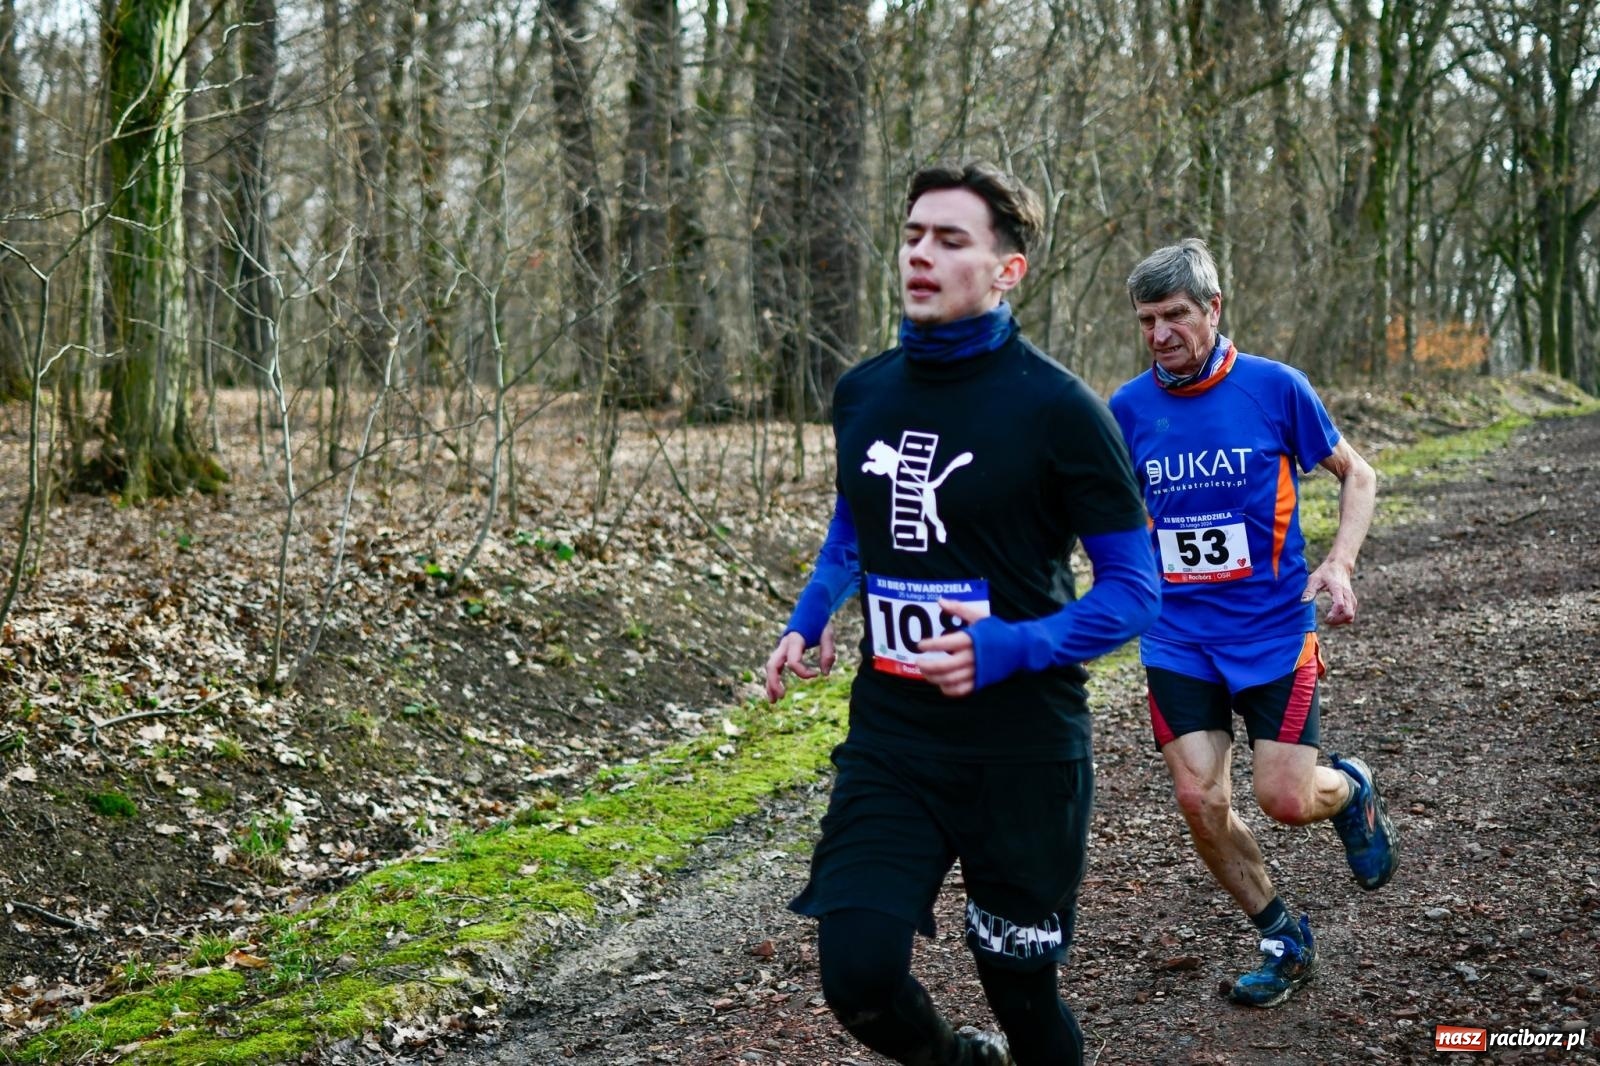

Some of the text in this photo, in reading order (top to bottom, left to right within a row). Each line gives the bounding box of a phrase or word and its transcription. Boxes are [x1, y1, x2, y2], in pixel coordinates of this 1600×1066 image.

[1145, 447, 1252, 485] DUKAT
[1152, 478, 1247, 495] www.dukatrolety.pl
[1163, 511, 1232, 524] XII BIEG TWARDZIELA
[1175, 529, 1230, 567] 53
[877, 578, 973, 594] XII BIEG TWARDZIELA
